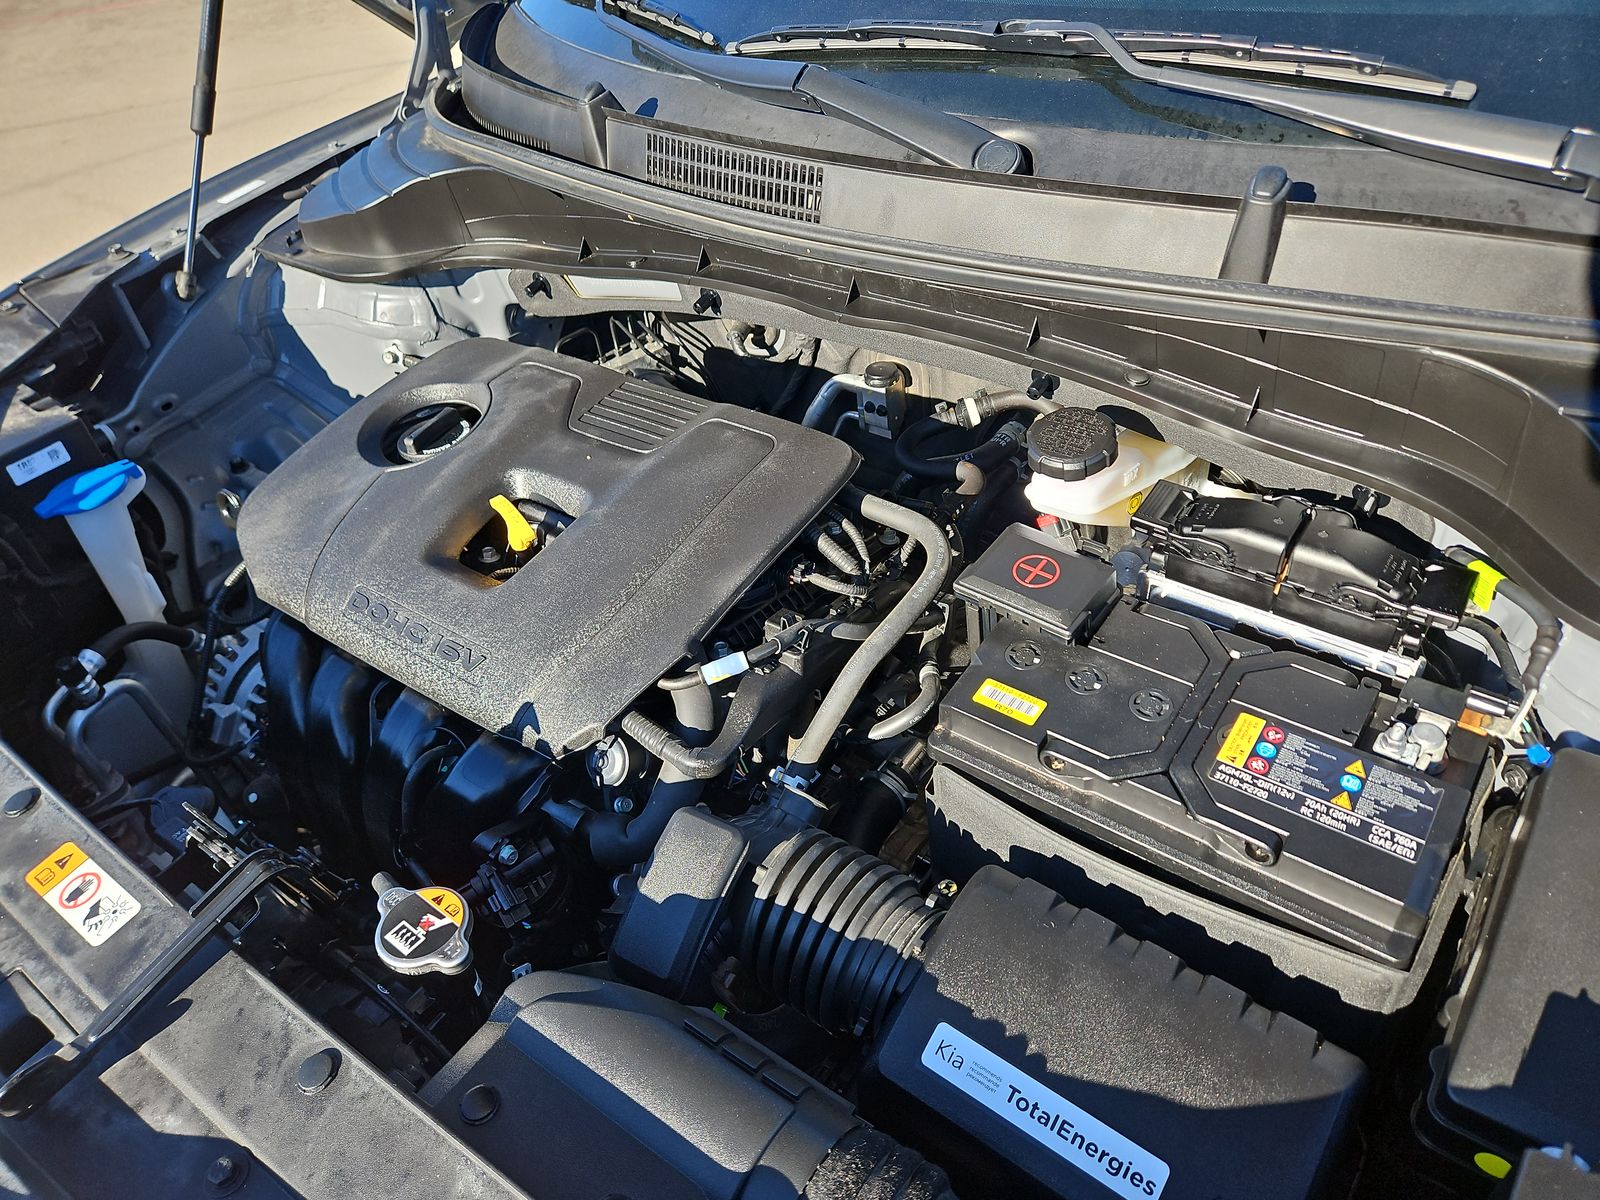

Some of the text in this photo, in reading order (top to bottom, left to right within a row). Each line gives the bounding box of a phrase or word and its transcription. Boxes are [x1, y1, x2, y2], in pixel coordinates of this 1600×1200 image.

[347, 588, 487, 672] DOHC 16V
[909, 715, 923, 725] FUEL
[1214, 771, 1269, 800] 37110-F2720
[1300, 806, 1348, 832] RC 120min
[1304, 798, 1361, 828] 70Ah (20HR)
[1371, 825, 1418, 852] CCA 760A
[935, 1039, 964, 1070] Kia
[969, 1066, 1000, 1089] recommande
[972, 1061, 1002, 1083] recommends
[1006, 1084, 1157, 1196] TotalEnergies
